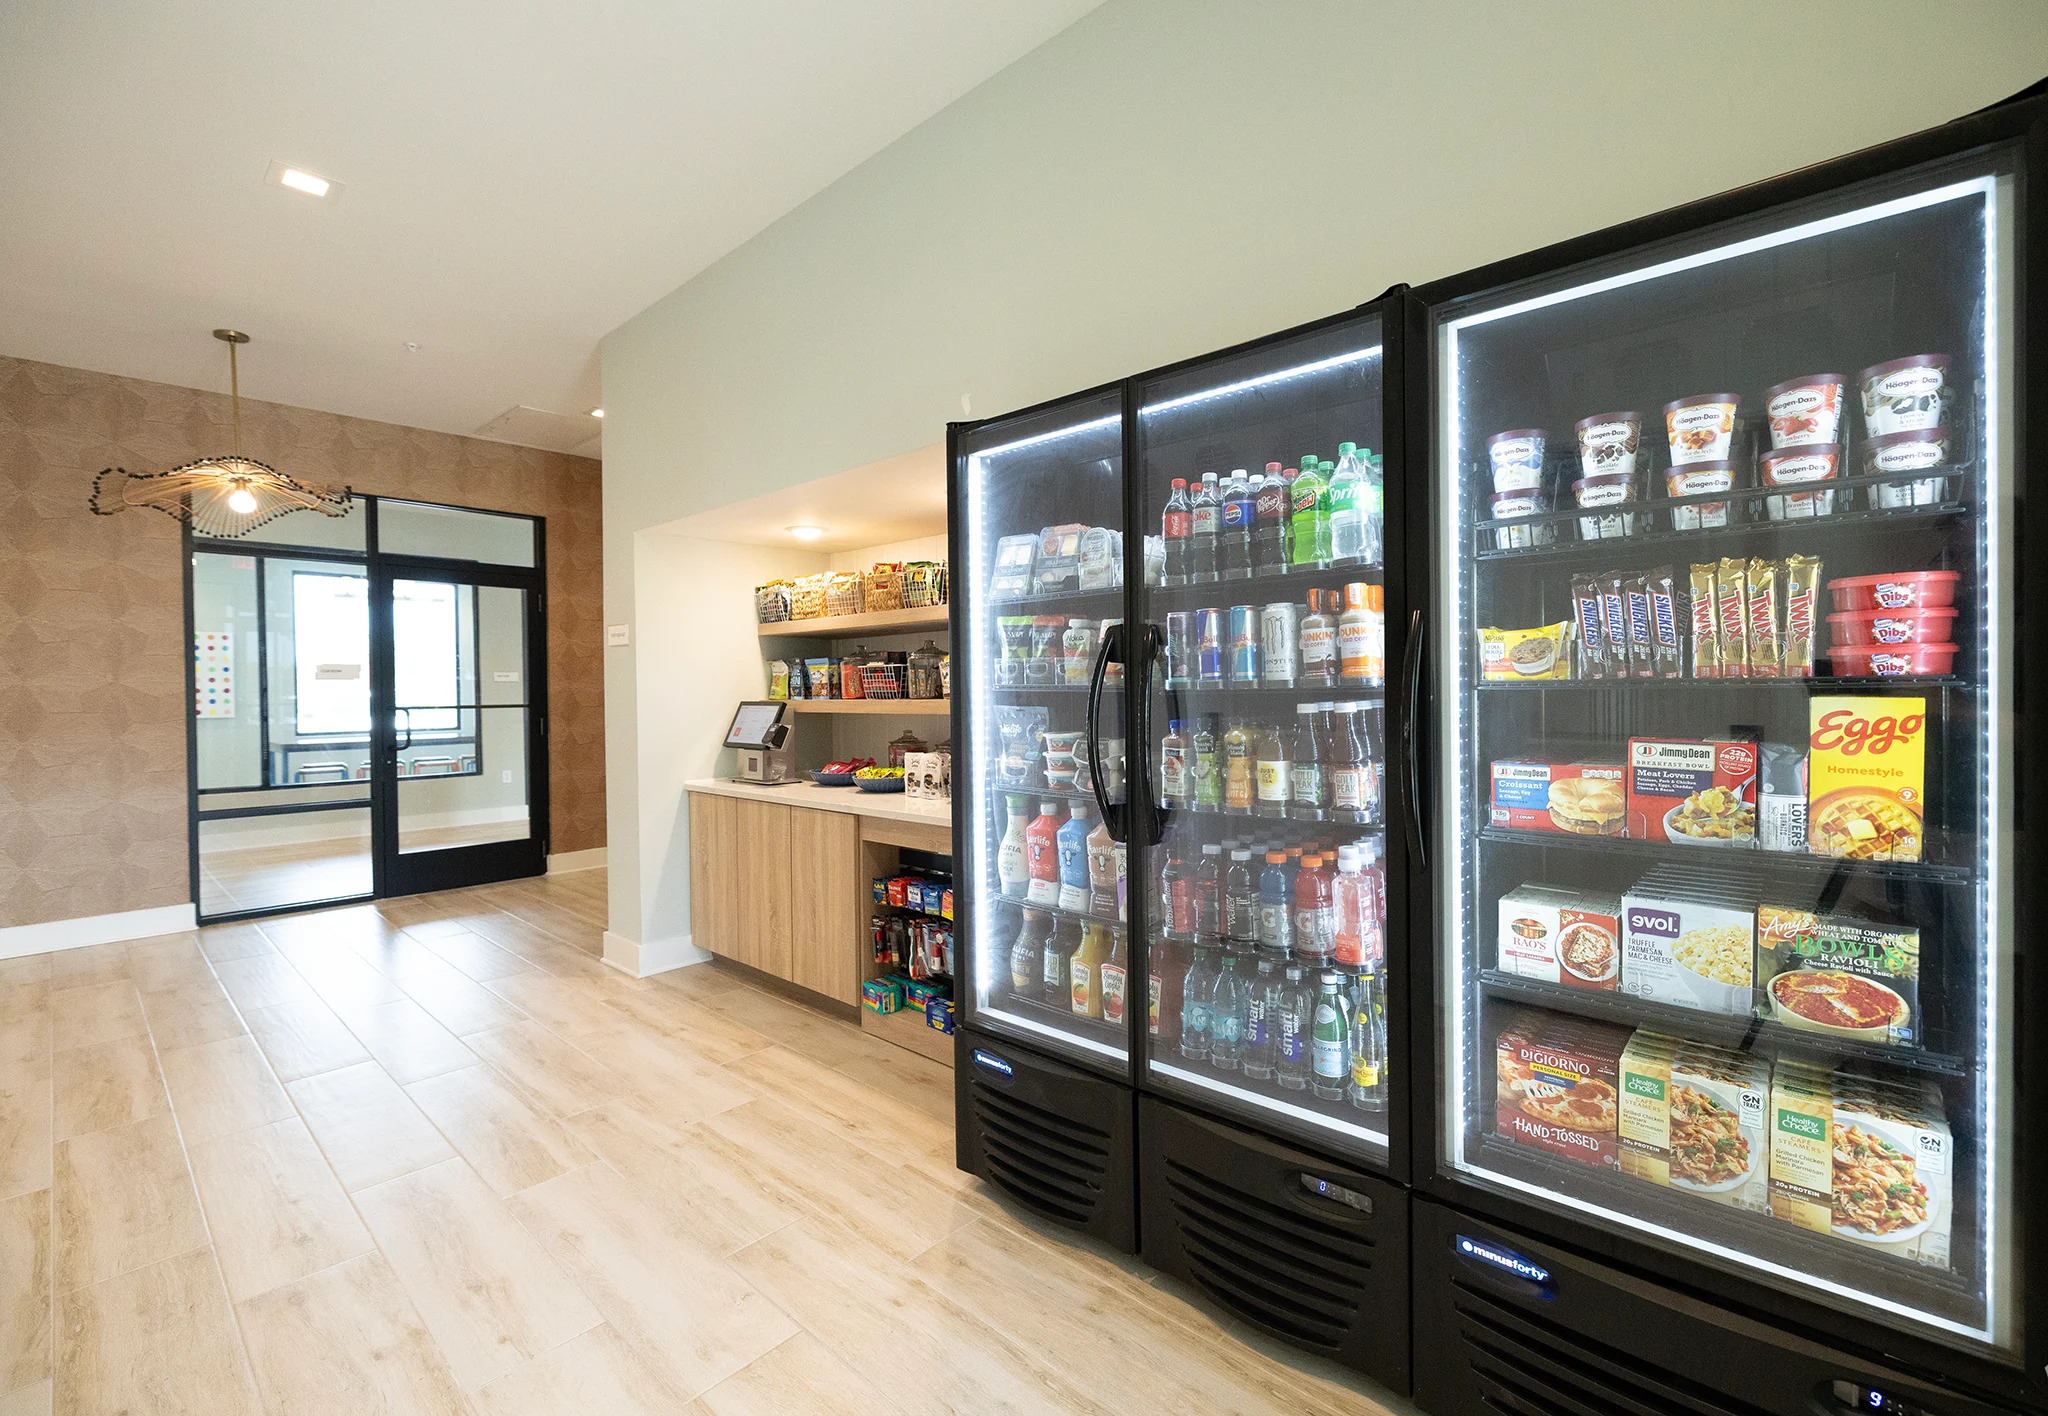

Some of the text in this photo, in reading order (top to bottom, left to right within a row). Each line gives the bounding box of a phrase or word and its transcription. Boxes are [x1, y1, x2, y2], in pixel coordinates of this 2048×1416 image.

[1880, 592, 1909, 602] Dibs
[1607, 596, 1626, 644] SNICKERS
[1630, 593, 1649, 643] SNICKERS
[1655, 595, 1677, 645] SNICKERS
[1691, 592, 1714, 644] TWIX
[1719, 589, 1744, 642] TWIX
[1749, 589, 1774, 642] TWIX
[1789, 589, 1813, 643] TWIX
[1582, 600, 1600, 648] SNICKERS
[1878, 628, 1907, 638] Dibs
[1876, 663, 1905, 673] Dibs
[1811, 710, 1925, 755] Eggo
[1659, 747, 1711, 759] Jimmy Dean
[1719, 753, 1753, 763] PROTEIN
[1636, 760, 1683, 768] BREAKFAST
[1827, 765, 1904, 778] Homestyle
[1512, 768, 1548, 778] Jimmy Dean
[1636, 769, 1696, 780] Meat Lovers
[1296, 780, 1313, 789] PEAK
[1336, 784, 1356, 794] PEAK
[1498, 780, 1543, 789] Croissant
[1903, 790, 1912, 800] 9
[1791, 803, 1803, 847] LOVERS
[1903, 836, 1916, 845] 10
[1759, 916, 1814, 940] Amy's
[1810, 929, 1840, 939] WHEAT
[1841, 934, 1861, 942] AND
[1814, 923, 1903, 941] MADE WITH ORGANIC
[1513, 937, 1547, 951] RAO'S
[1627, 945, 1663, 957] PARMESAN
[1628, 938, 1656, 949] TRUFFLE
[1627, 951, 1643, 960] MAC
[1649, 956, 1673, 966] CHEESE
[1792, 934, 1906, 971] BOWLS
[1803, 958, 1895, 978] Cheese Ravioli with Sauce
[1820, 953, 1879, 969] RAVIOLI
[1247, 999, 1260, 1042] smart
[1282, 1012, 1294, 1057] smart
[1520, 1049, 1590, 1076] DIGIORNO
[1532, 1064, 1577, 1080] PERSONAL SIZE
[1628, 1082, 1660, 1096] Choice
[1632, 1077, 1659, 1090] Healthy
[1625, 1099, 1662, 1113] STEAMERS
[1742, 1094, 1760, 1105] ON
[1743, 1101, 1760, 1110] TRACK
[1623, 1108, 1664, 1124] Grilled Chicken
[1786, 1114, 1819, 1128] Healthy
[1512, 1117, 1599, 1151] HAND-TOSSED
[1623, 1119, 1636, 1127] with
[1636, 1121, 1664, 1134] Parmesan
[1781, 1119, 1820, 1135] Choice
[1634, 1141, 1660, 1153] PROTEIN
[1778, 1138, 1822, 1154] STEAMERS
[1920, 1136, 1941, 1147] ON
[1920, 1143, 1941, 1153] TRACK
[1775, 1149, 1826, 1166] Grilled Chicken
[1775, 1153, 1805, 1165] Marinara
[1776, 1160, 1790, 1168] with
[1791, 1163, 1824, 1176] Parmesan
[1775, 1181, 1820, 1198] 20g PROTEIN
[1473, 1243, 1547, 1281] minusforty
[1869, 1391, 1883, 1407] 9
